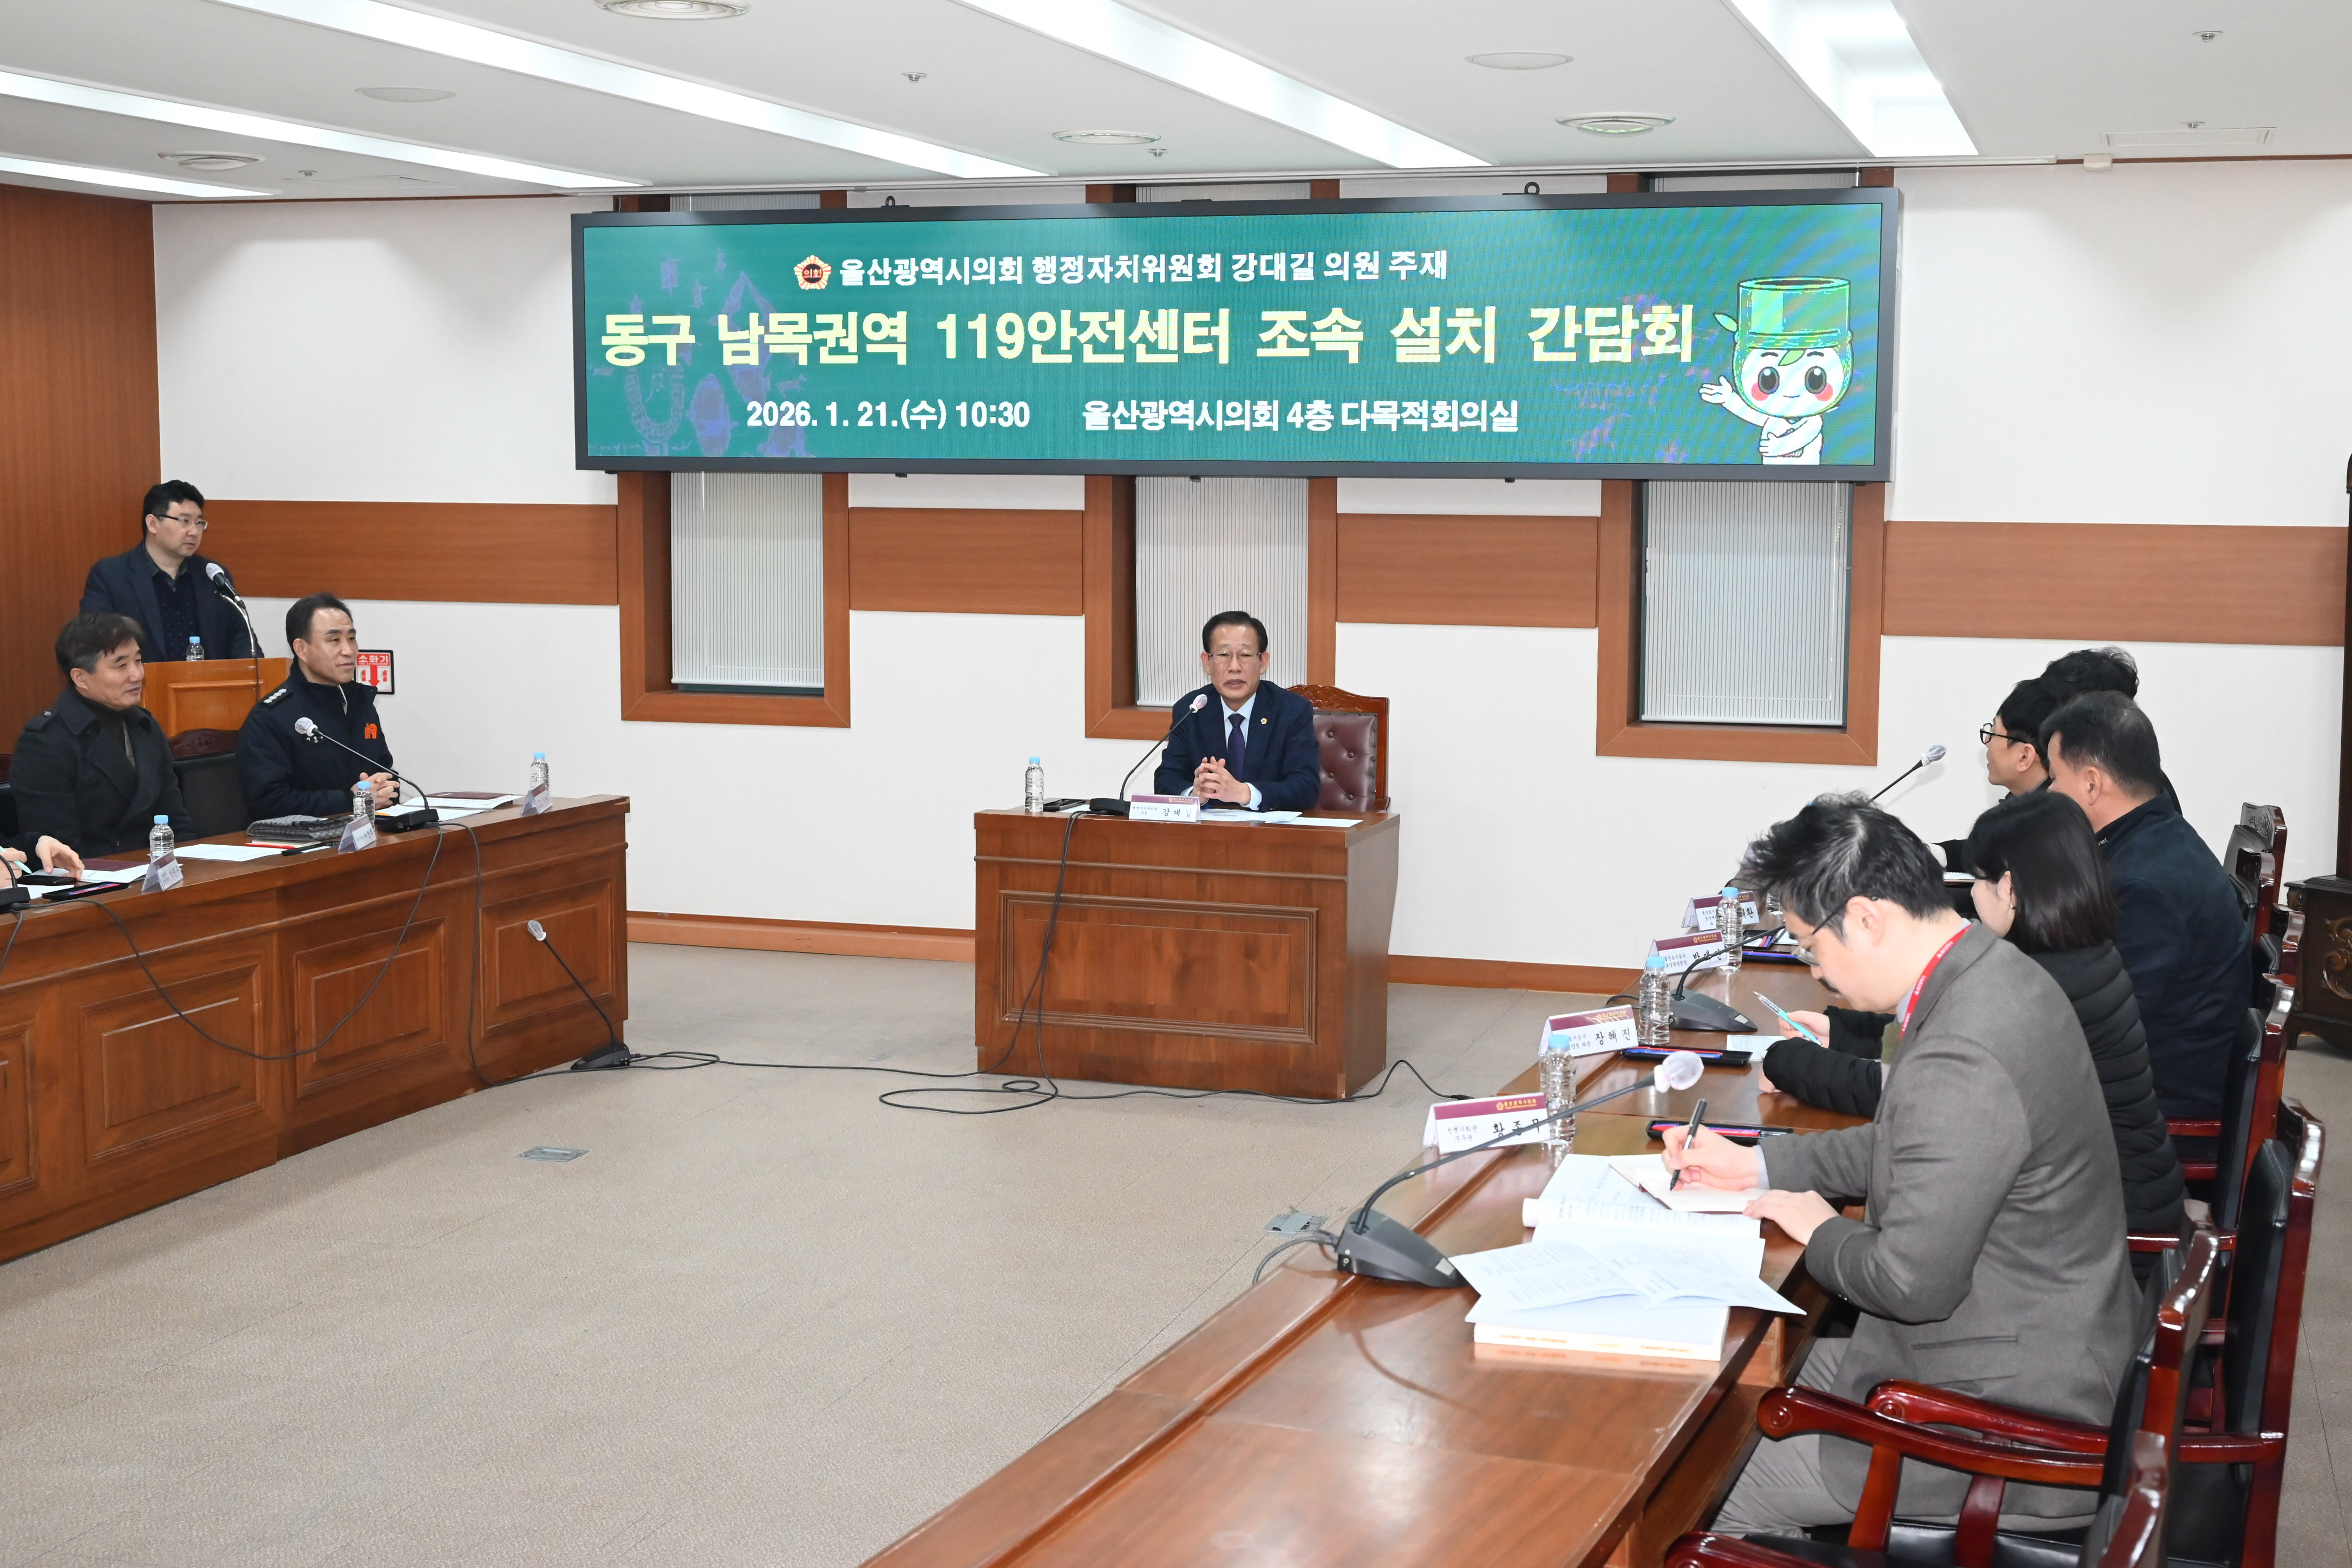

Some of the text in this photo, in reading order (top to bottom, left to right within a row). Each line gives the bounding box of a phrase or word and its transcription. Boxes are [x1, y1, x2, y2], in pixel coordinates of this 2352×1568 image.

[840, 251, 1447, 286] 울산광역시의회 행정자치위원회 강대길 의원 주재
[602, 304, 1694, 367] 동구 남목권역 119안전센터 조속 설치 간담회
[747, 400, 1030, 430] 2026. 1. 21.(수) 10:30
[1083, 400, 1519, 433] 울산광역시의회 4층 다목적회의실
[358, 655, 389, 663] 소화기
